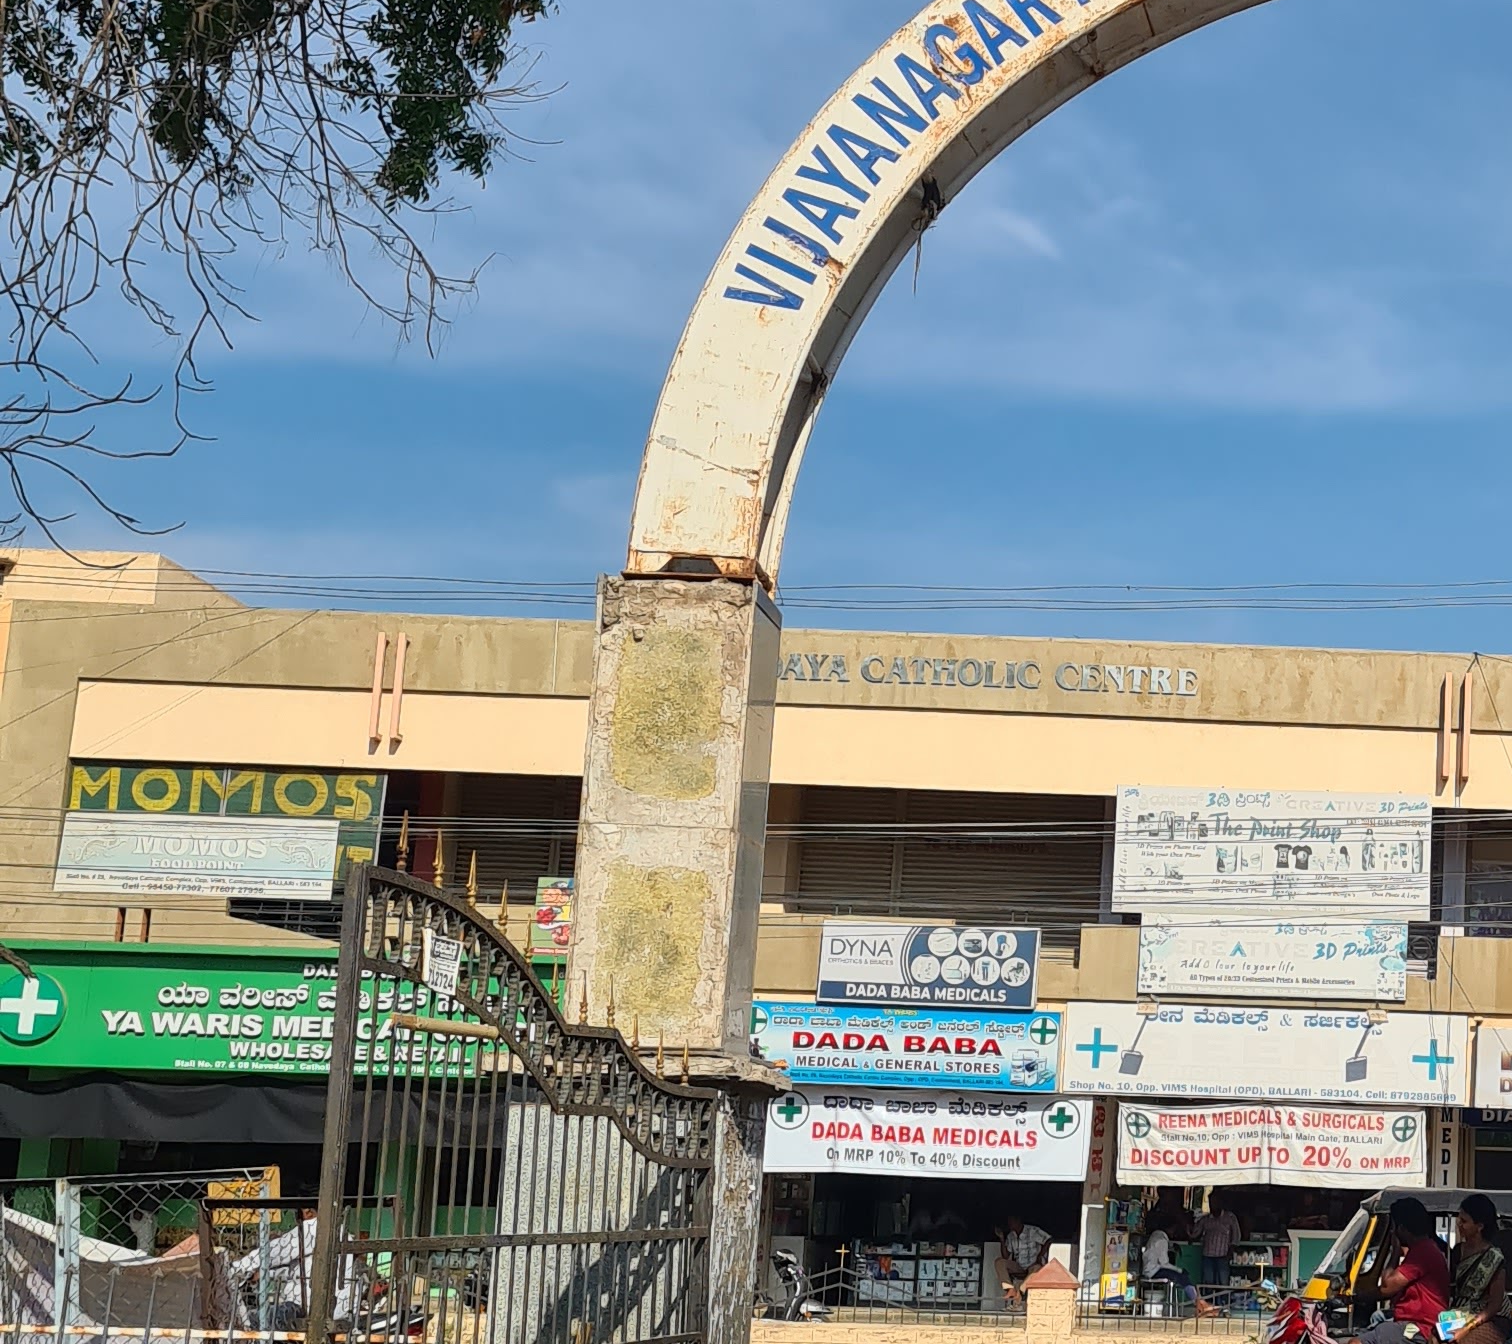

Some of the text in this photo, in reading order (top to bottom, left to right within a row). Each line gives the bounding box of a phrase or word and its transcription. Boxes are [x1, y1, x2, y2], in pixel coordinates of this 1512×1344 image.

[860, 656, 1041, 690] CATHOLIC
[1054, 662, 1199, 696] CENTRE
[69, 766, 377, 821] MOMOS
[1378, 801, 1395, 814] 3D
[1207, 812, 1243, 836] The
[1299, 819, 1342, 844] Shop
[132, 835, 268, 859] MOMOS
[830, 937, 893, 958] DYNA
[1313, 942, 1338, 960] 3D
[1342, 942, 1388, 961] Prints
[158, 982, 210, 1006] ಯಾ
[845, 983, 1007, 1002] DADA BABA MEDICALS
[102, 1010, 145, 1036] YA
[151, 1012, 264, 1039] WARIS
[1280, 1013, 1293, 1027] &
[373, 1046, 389, 1062] &
[792, 1031, 1004, 1056] DADA BABA
[796, 1056, 1001, 1074] MEDICAL & GENERAL STORES
[1069, 1080, 1095, 1092] Shop
[1098, 1082, 1114, 1091] No.
[1136, 1083, 1159, 1094] Opp.
[1161, 1083, 1188, 1093] VIMS
[1190, 1084, 1232, 1096] Hospital
[1268, 1087, 1312, 1097] BALLARI
[823, 1094, 874, 1110] ದಾದಾ
[885, 1098, 938, 1115] ಬಾಬಾ
[1158, 1109, 1385, 1131] REENA MEDICALS & SURGICALS
[811, 1122, 1039, 1148] DADA BABA MEDICALS
[1212, 1132, 1230, 1143] Opp
[1238, 1131, 1259, 1139] VIMS
[1343, 1136, 1383, 1145] BALLARI
[826, 1147, 1021, 1169] On MRP 10% To 40% Discount
[1130, 1145, 1411, 1169] DISCOUNT UP TO 20% ON MRP
